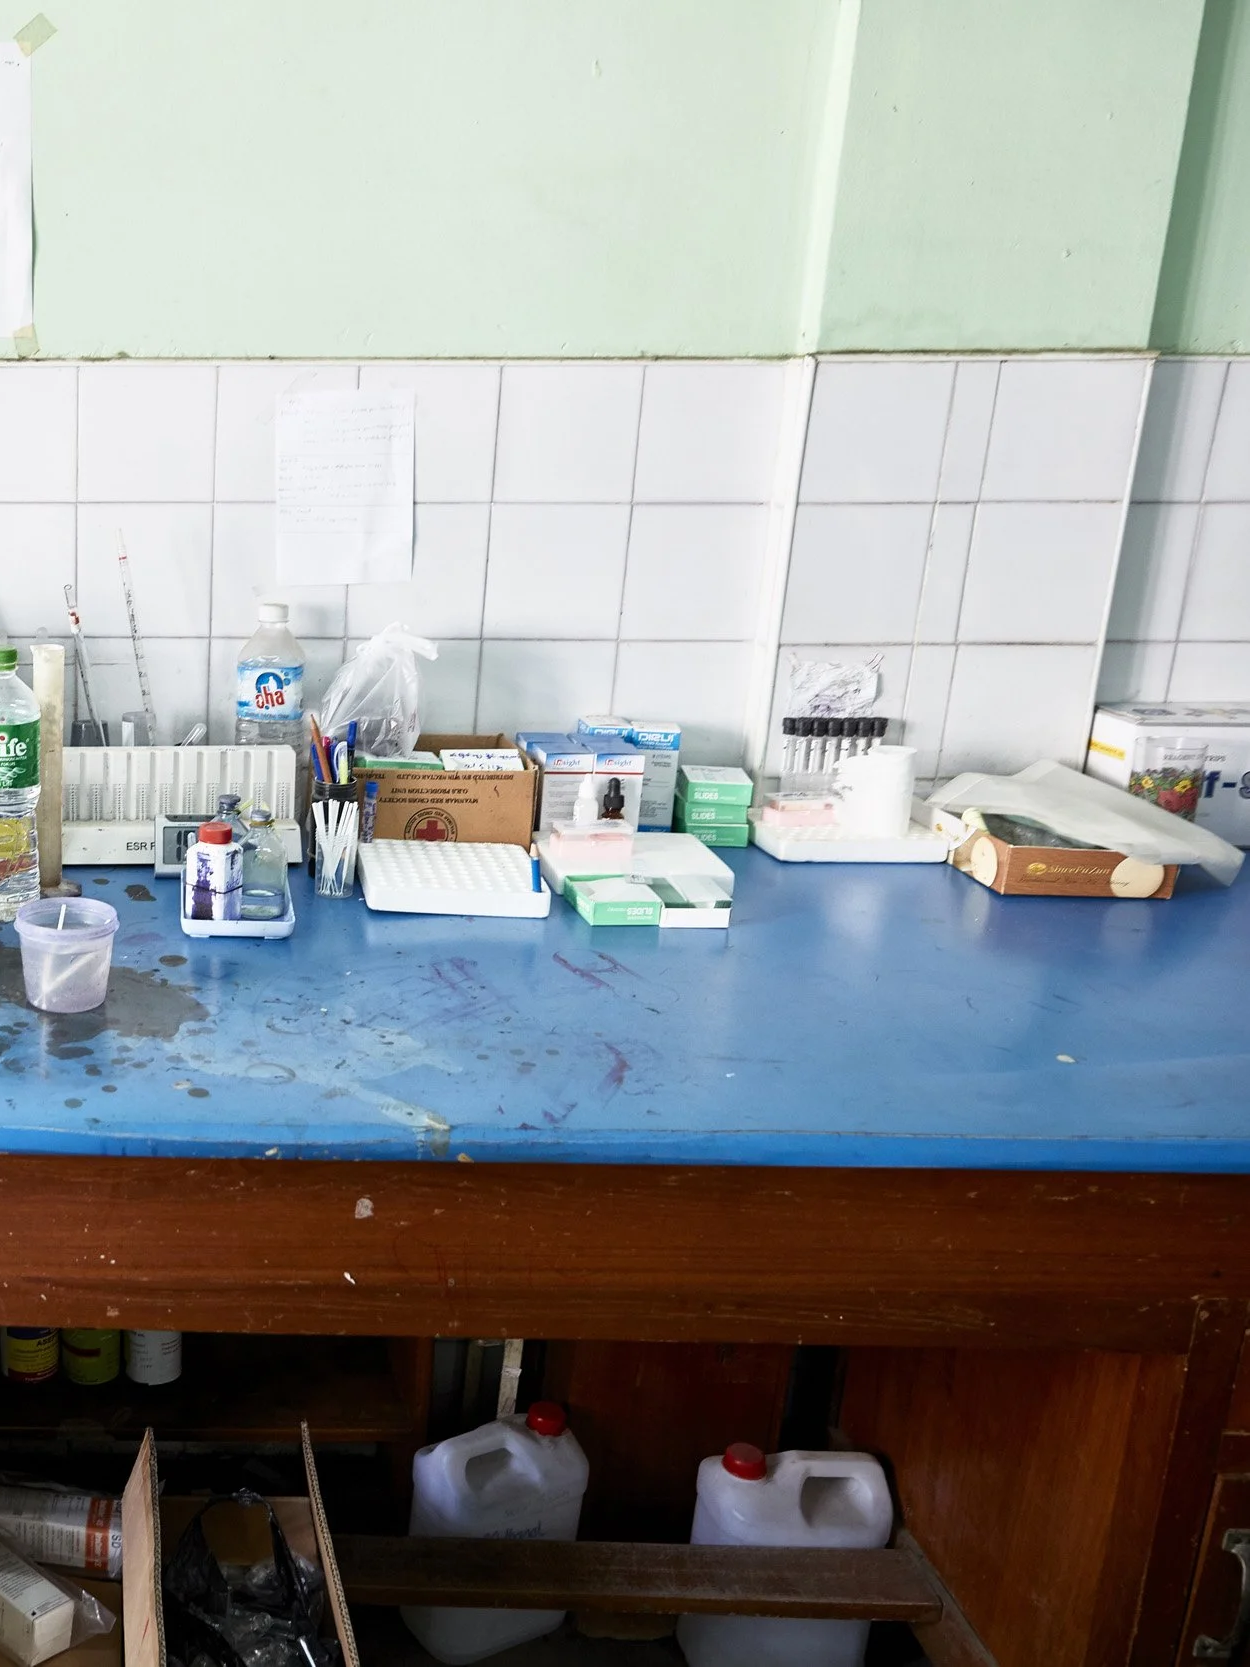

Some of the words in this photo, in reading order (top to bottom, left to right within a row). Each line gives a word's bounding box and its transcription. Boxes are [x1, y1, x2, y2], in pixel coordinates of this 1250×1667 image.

[407, 787, 451, 795] PRODUCTION
[378, 796, 408, 804] SOCIETY
[445, 796, 479, 804] MYANMAR
[125, 841, 148, 851] ESR
